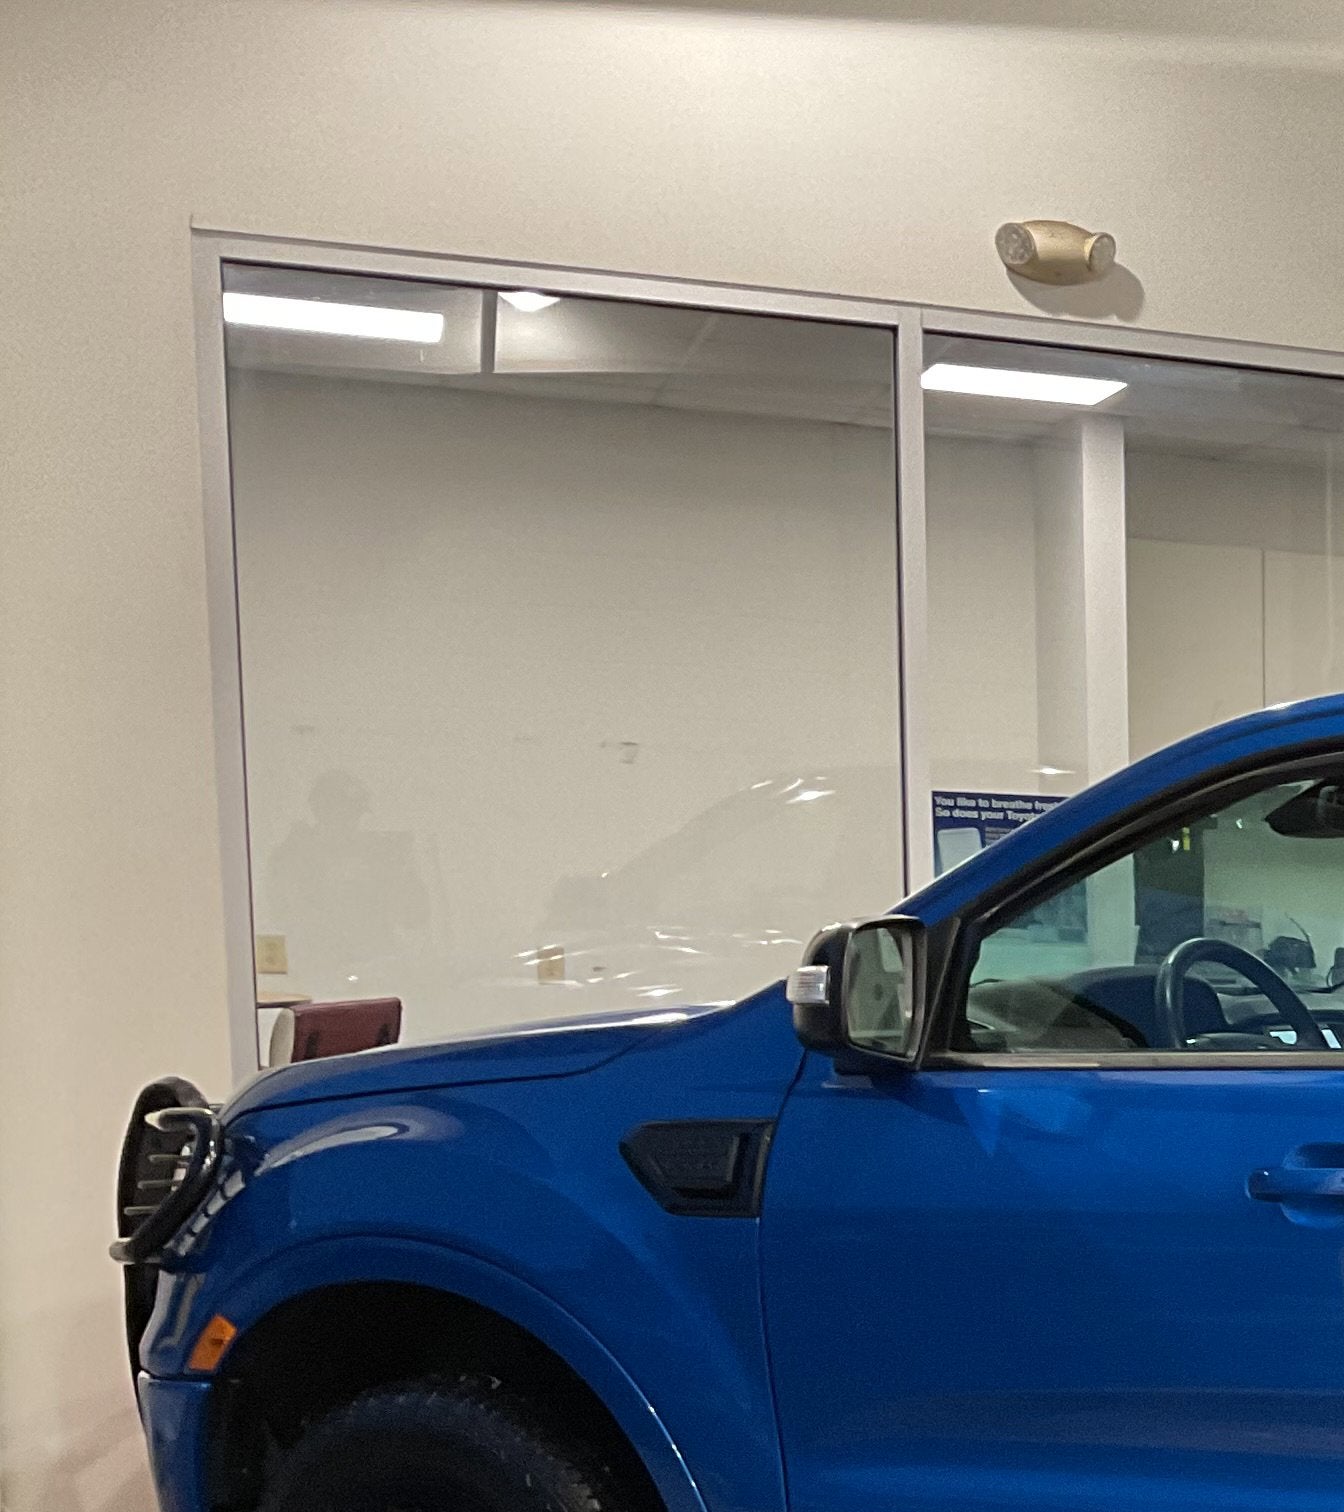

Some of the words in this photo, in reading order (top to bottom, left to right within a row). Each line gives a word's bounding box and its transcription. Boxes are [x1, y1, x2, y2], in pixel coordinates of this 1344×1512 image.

[935, 796, 955, 807] You
[956, 797, 976, 807] like
[978, 798, 990, 808] to
[991, 799, 1033, 810] breathe
[935, 807, 950, 817] So
[952, 809, 979, 819] does
[980, 811, 1004, 821] your
